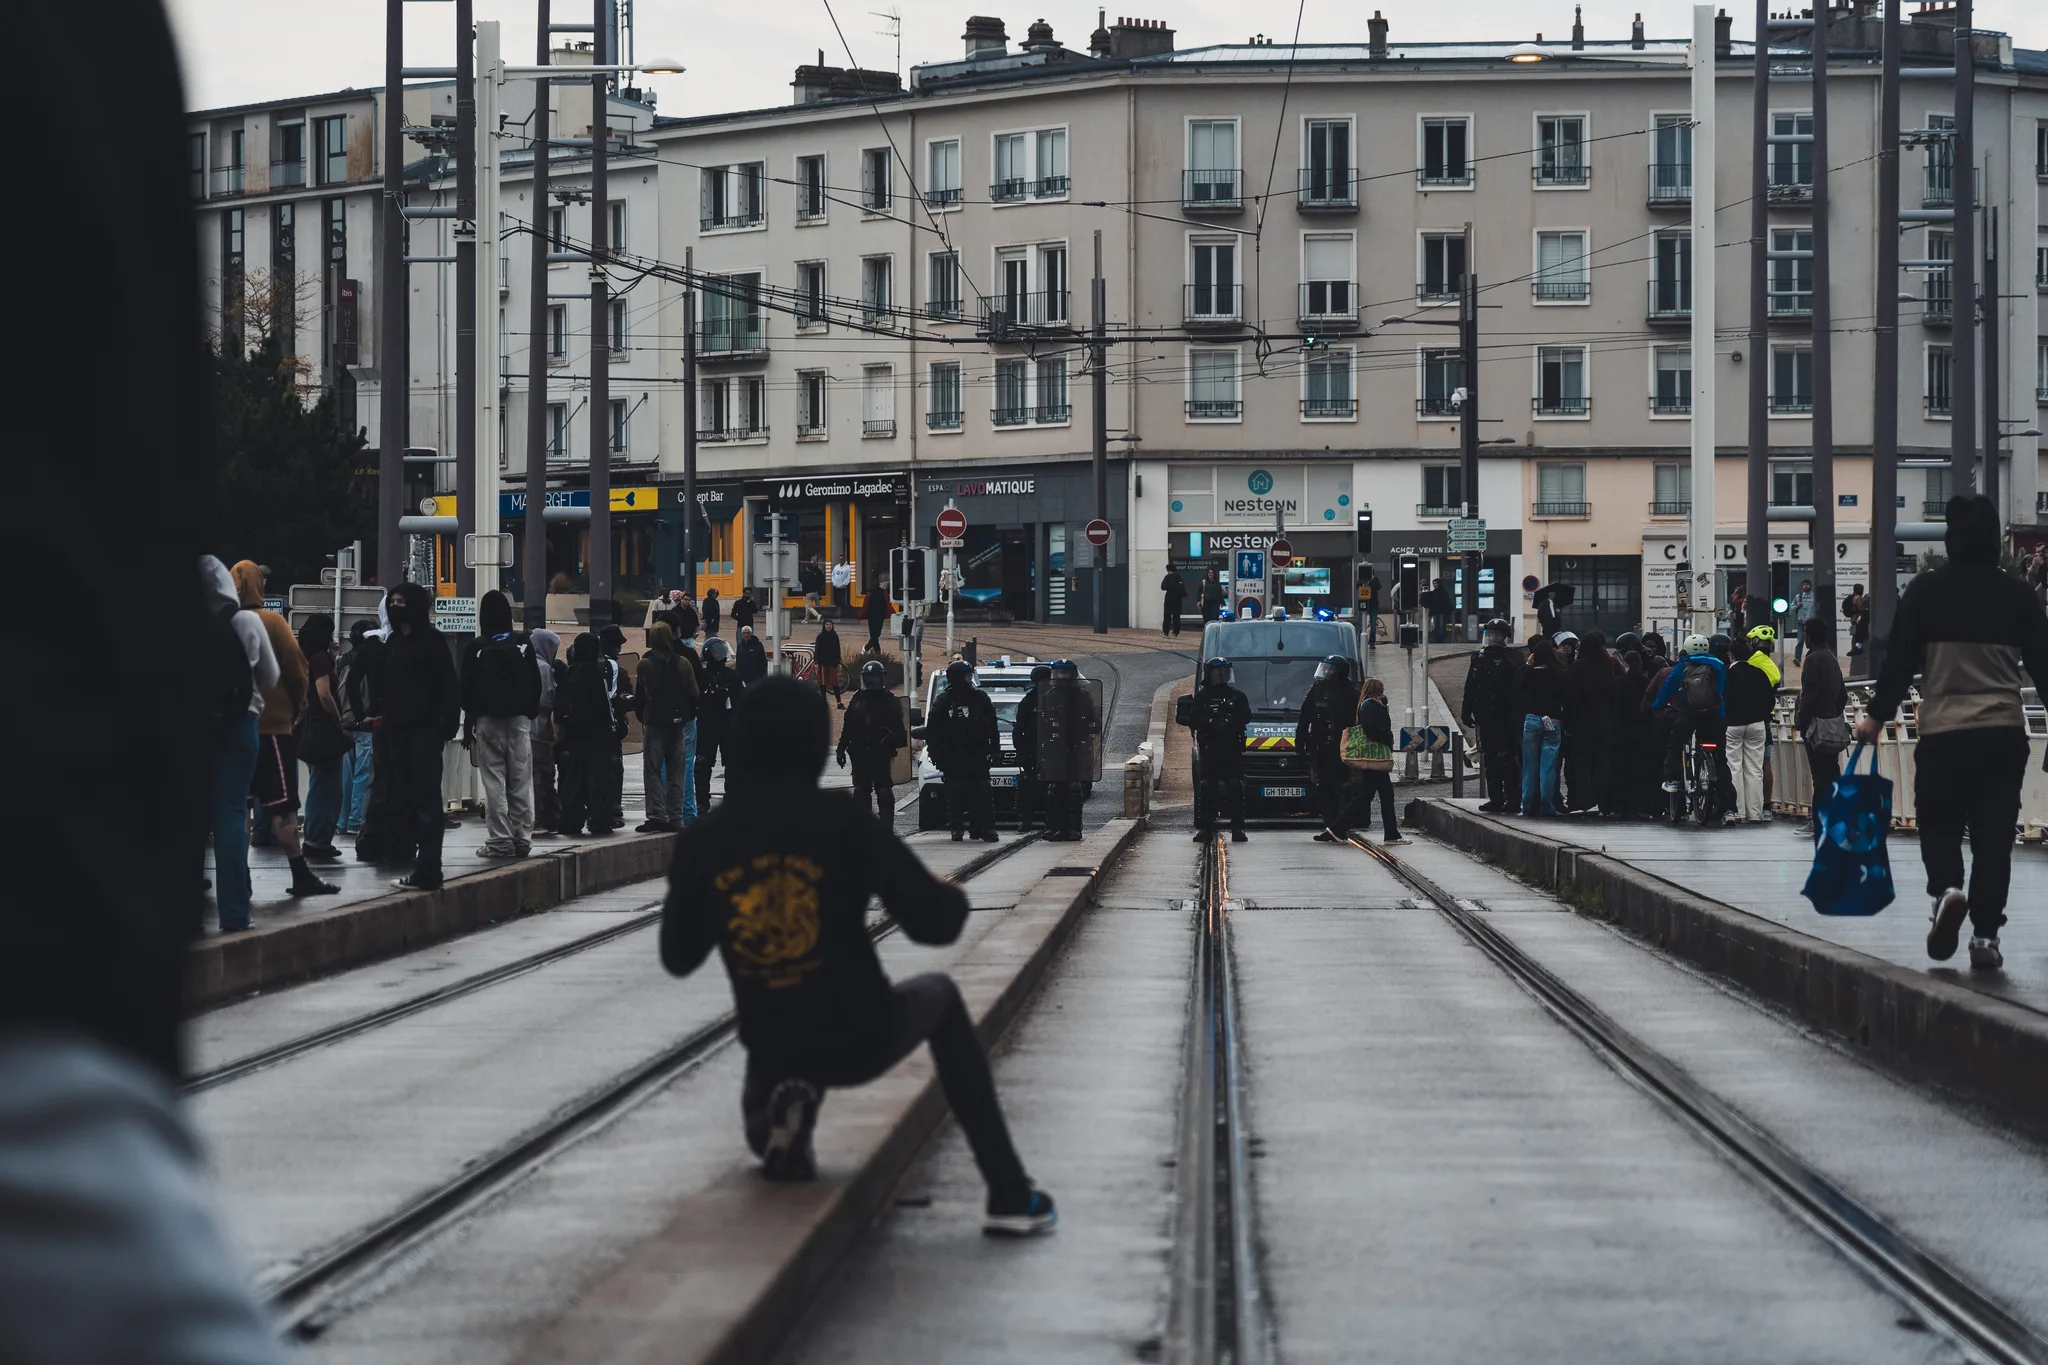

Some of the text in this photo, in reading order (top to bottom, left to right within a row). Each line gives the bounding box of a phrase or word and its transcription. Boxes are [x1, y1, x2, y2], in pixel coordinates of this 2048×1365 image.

[341, 288, 353, 297] ibis
[805, 483, 851, 497] Geronimo
[853, 479, 893, 498] Lagadec
[957, 480, 1035, 496] LAVOMATIQUE
[710, 490, 725, 502] Bar
[1265, 788, 1301, 796] GH-187-LB
